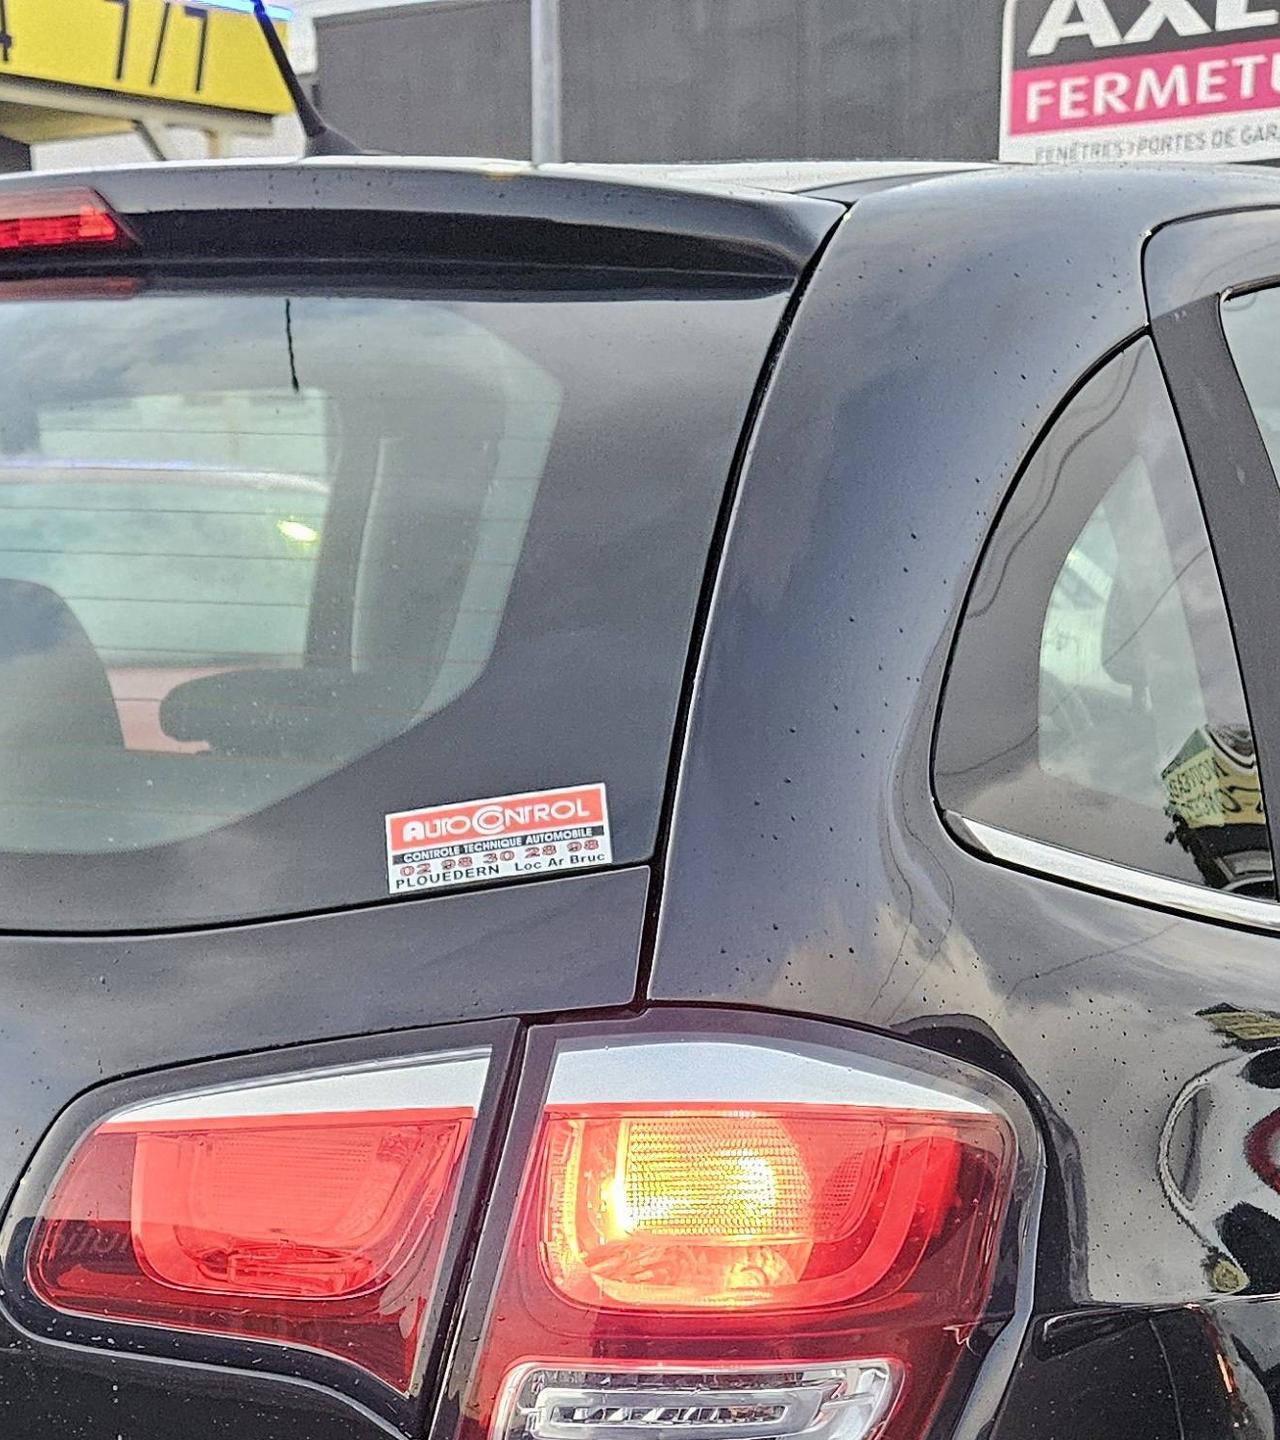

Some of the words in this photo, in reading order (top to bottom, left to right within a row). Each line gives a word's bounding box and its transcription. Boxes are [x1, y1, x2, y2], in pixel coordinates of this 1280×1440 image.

[463, 837, 522, 855] TECHNIQUE
[526, 827, 592, 845] AUTOMOBILE
[395, 864, 500, 889] PLOUEDERN
[515, 861, 542, 872] Loc
[548, 857, 565, 867] Ar
[569, 853, 606, 865] Bruc
[400, 863, 431, 877] 02
[483, 850, 515, 864] 30
[525, 844, 557, 859] 28
